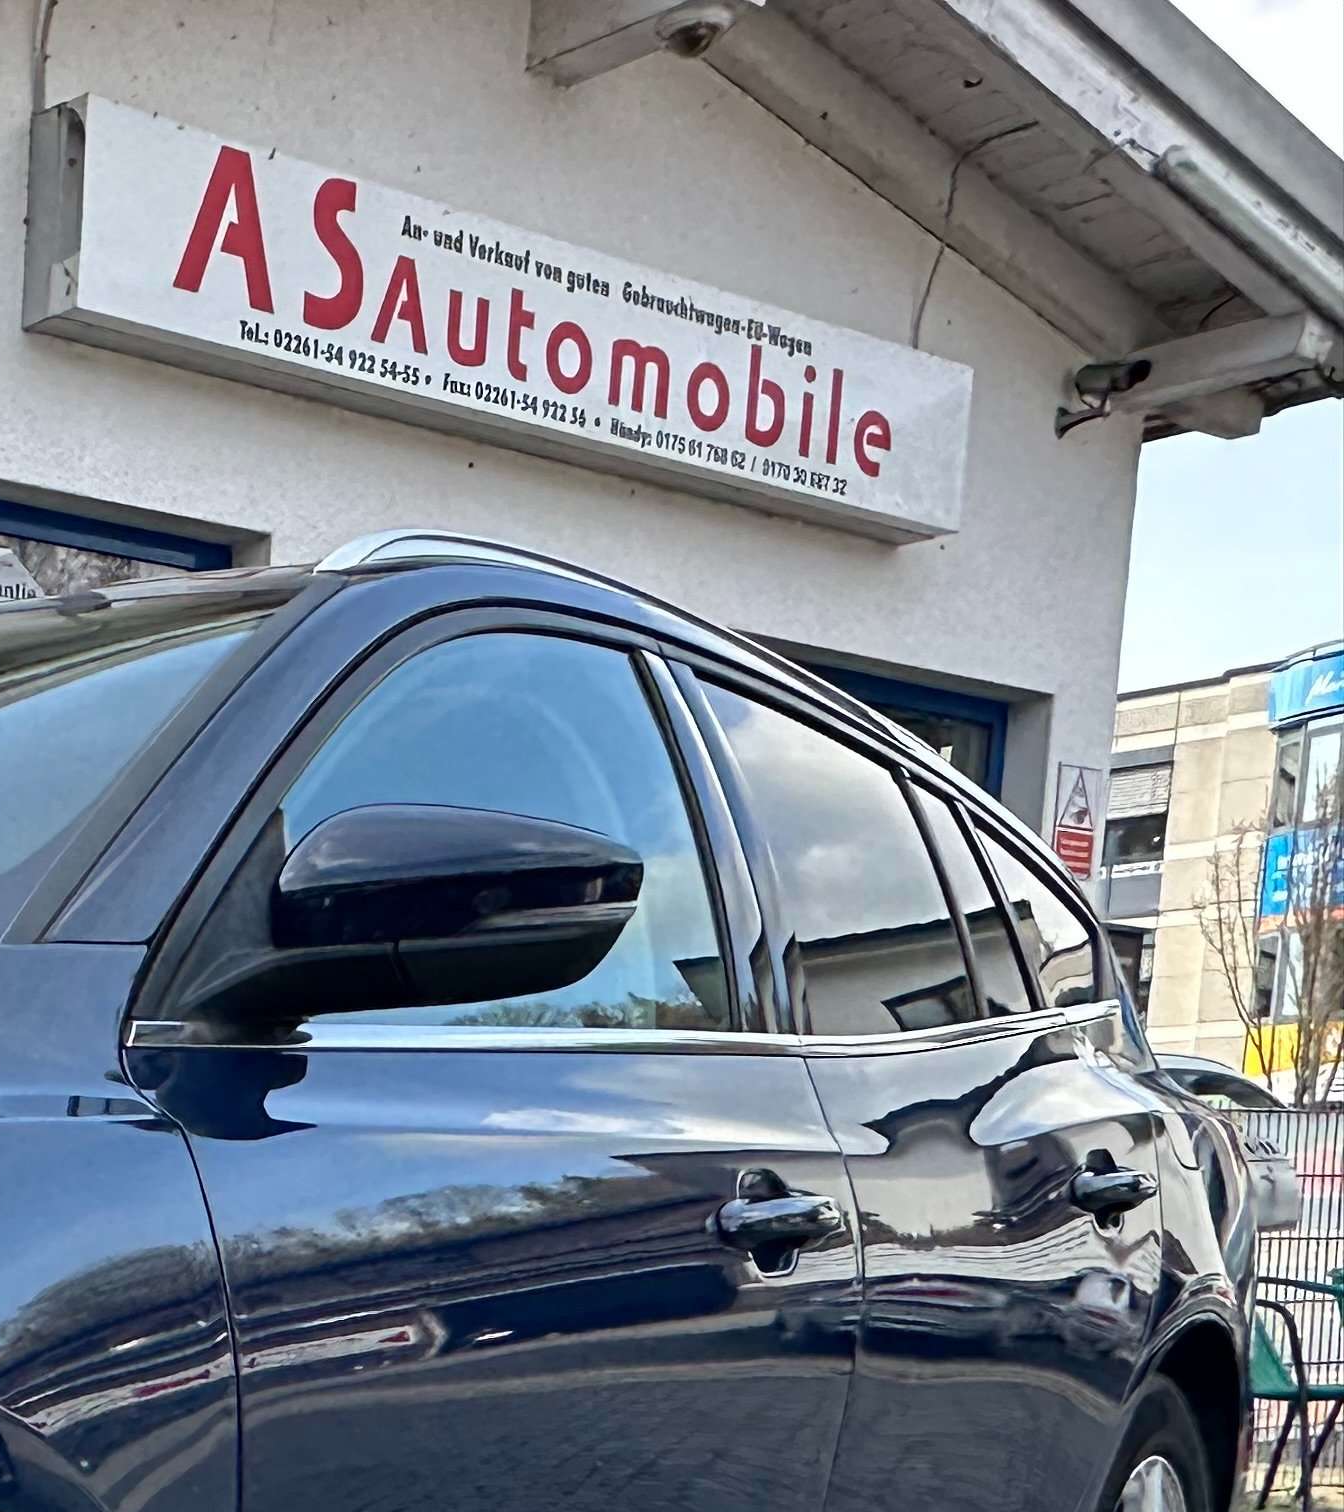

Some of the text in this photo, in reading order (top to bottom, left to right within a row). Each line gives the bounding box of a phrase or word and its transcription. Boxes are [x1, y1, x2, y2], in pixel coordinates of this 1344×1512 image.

[433, 229, 464, 254] und
[469, 233, 531, 274] Verkauf
[535, 259, 563, 284] von
[348, 349, 376, 374] 922
[542, 399, 567, 423] 922
[656, 430, 687, 456] 0175
